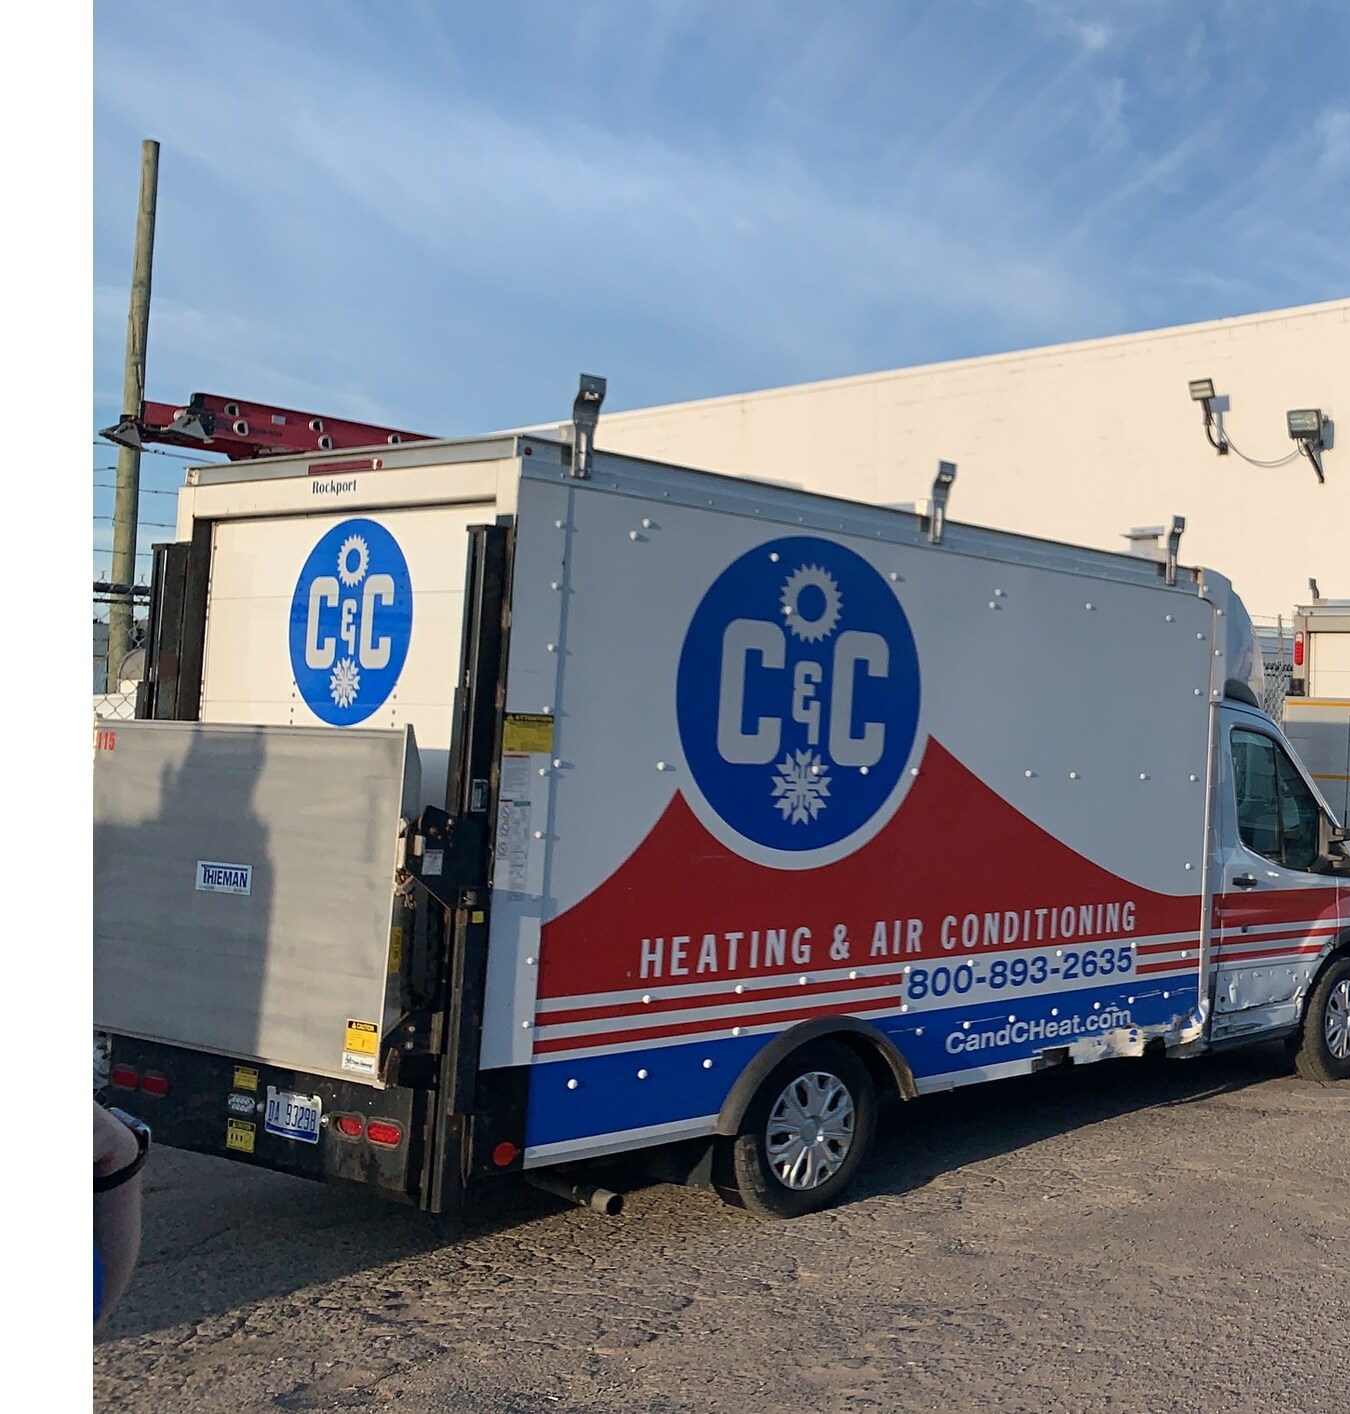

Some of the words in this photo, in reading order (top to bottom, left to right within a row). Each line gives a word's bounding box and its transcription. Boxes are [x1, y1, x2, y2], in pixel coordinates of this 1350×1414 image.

[312, 479, 357, 497] Rockport
[305, 574, 395, 670] C&C
[717, 617, 889, 767] C&C
[201, 864, 248, 888] THIEMAN
[639, 926, 812, 979] HEATING
[830, 923, 850, 960] &
[870, 919, 923, 956] AIR
[941, 901, 1137, 951] CONDITIONING
[908, 946, 1132, 1000] 800-893-2635
[945, 1008, 1132, 1054] CandCHeat.com
